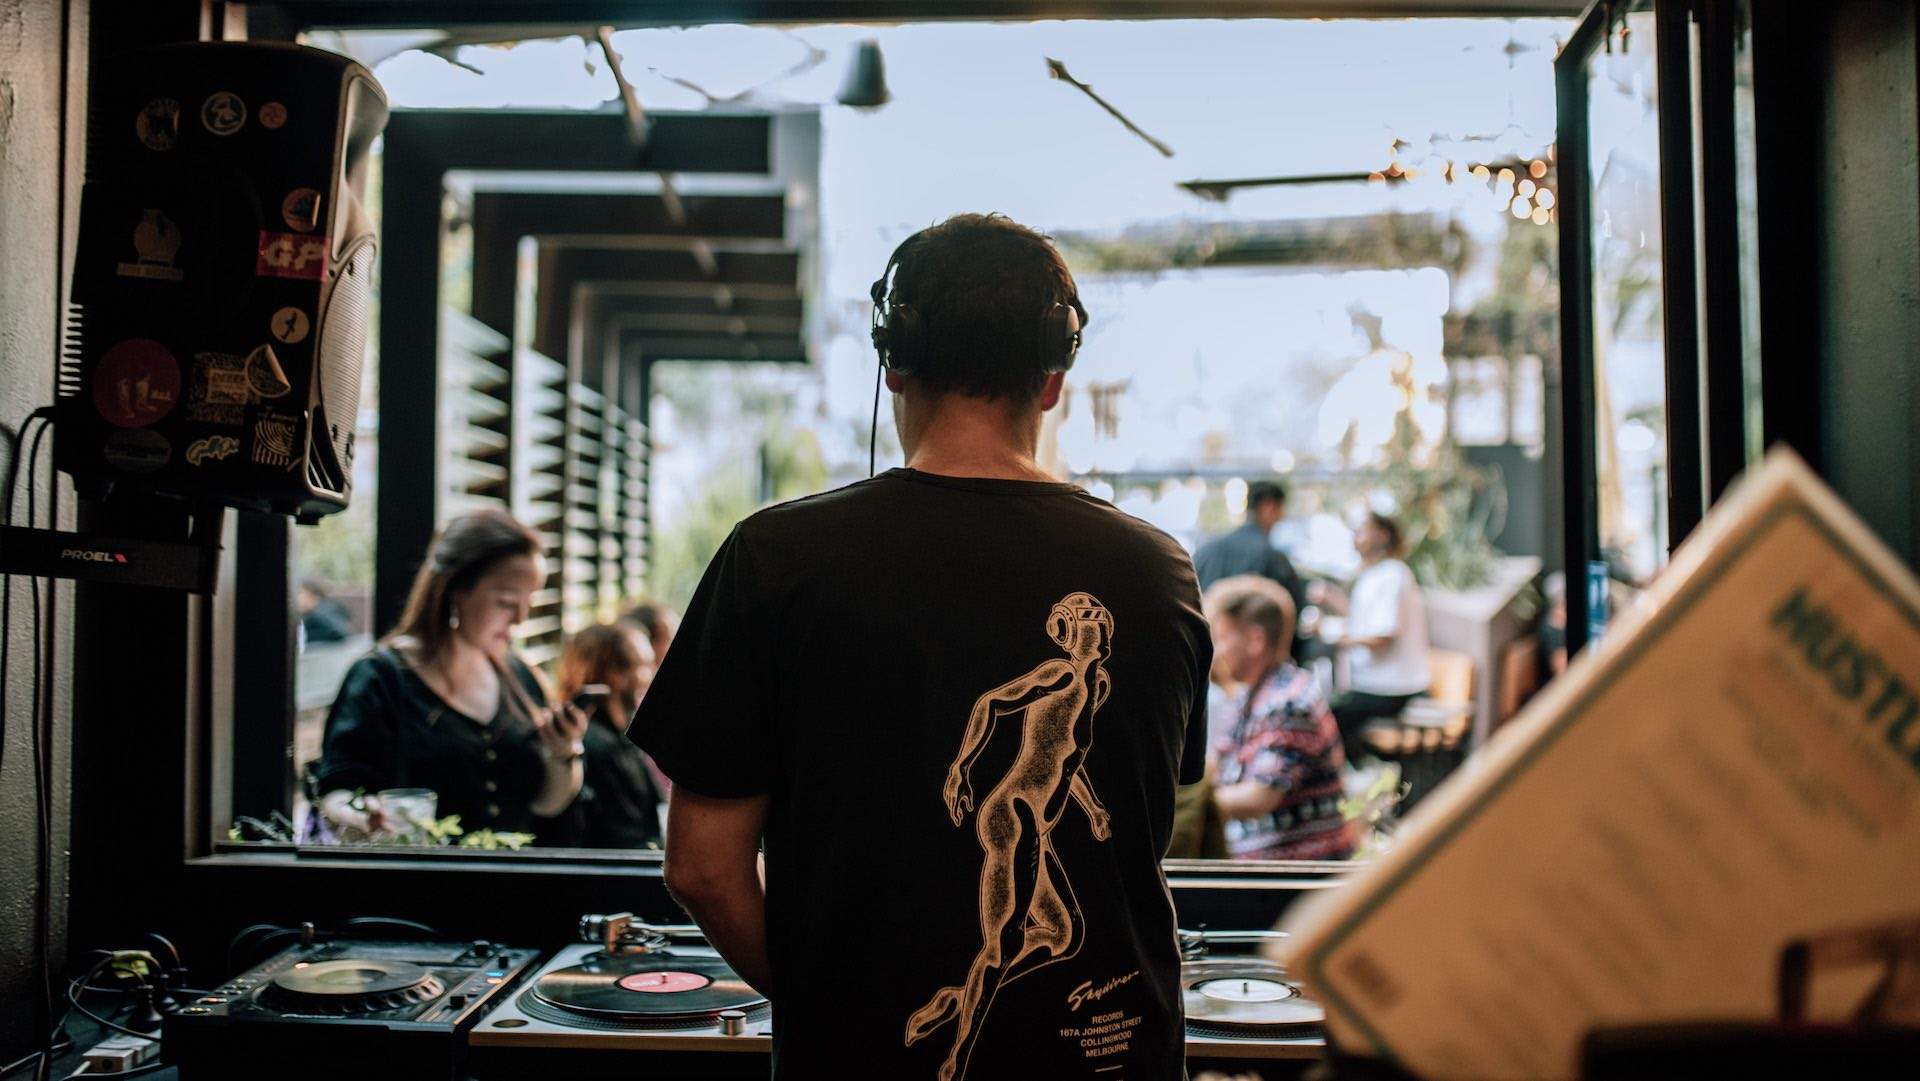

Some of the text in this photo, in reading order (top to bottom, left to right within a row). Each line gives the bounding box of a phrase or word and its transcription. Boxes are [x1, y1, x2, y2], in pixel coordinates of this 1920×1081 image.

[61, 549, 115, 563] PROEL
[1092, 1010, 1124, 1024] RECORDS
[1059, 1016, 1142, 1038] 167A JOHNSTON STREET
[1080, 1030, 1132, 1047] COLLINGWOOD
[1085, 1042, 1129, 1057] MELBOURNE
